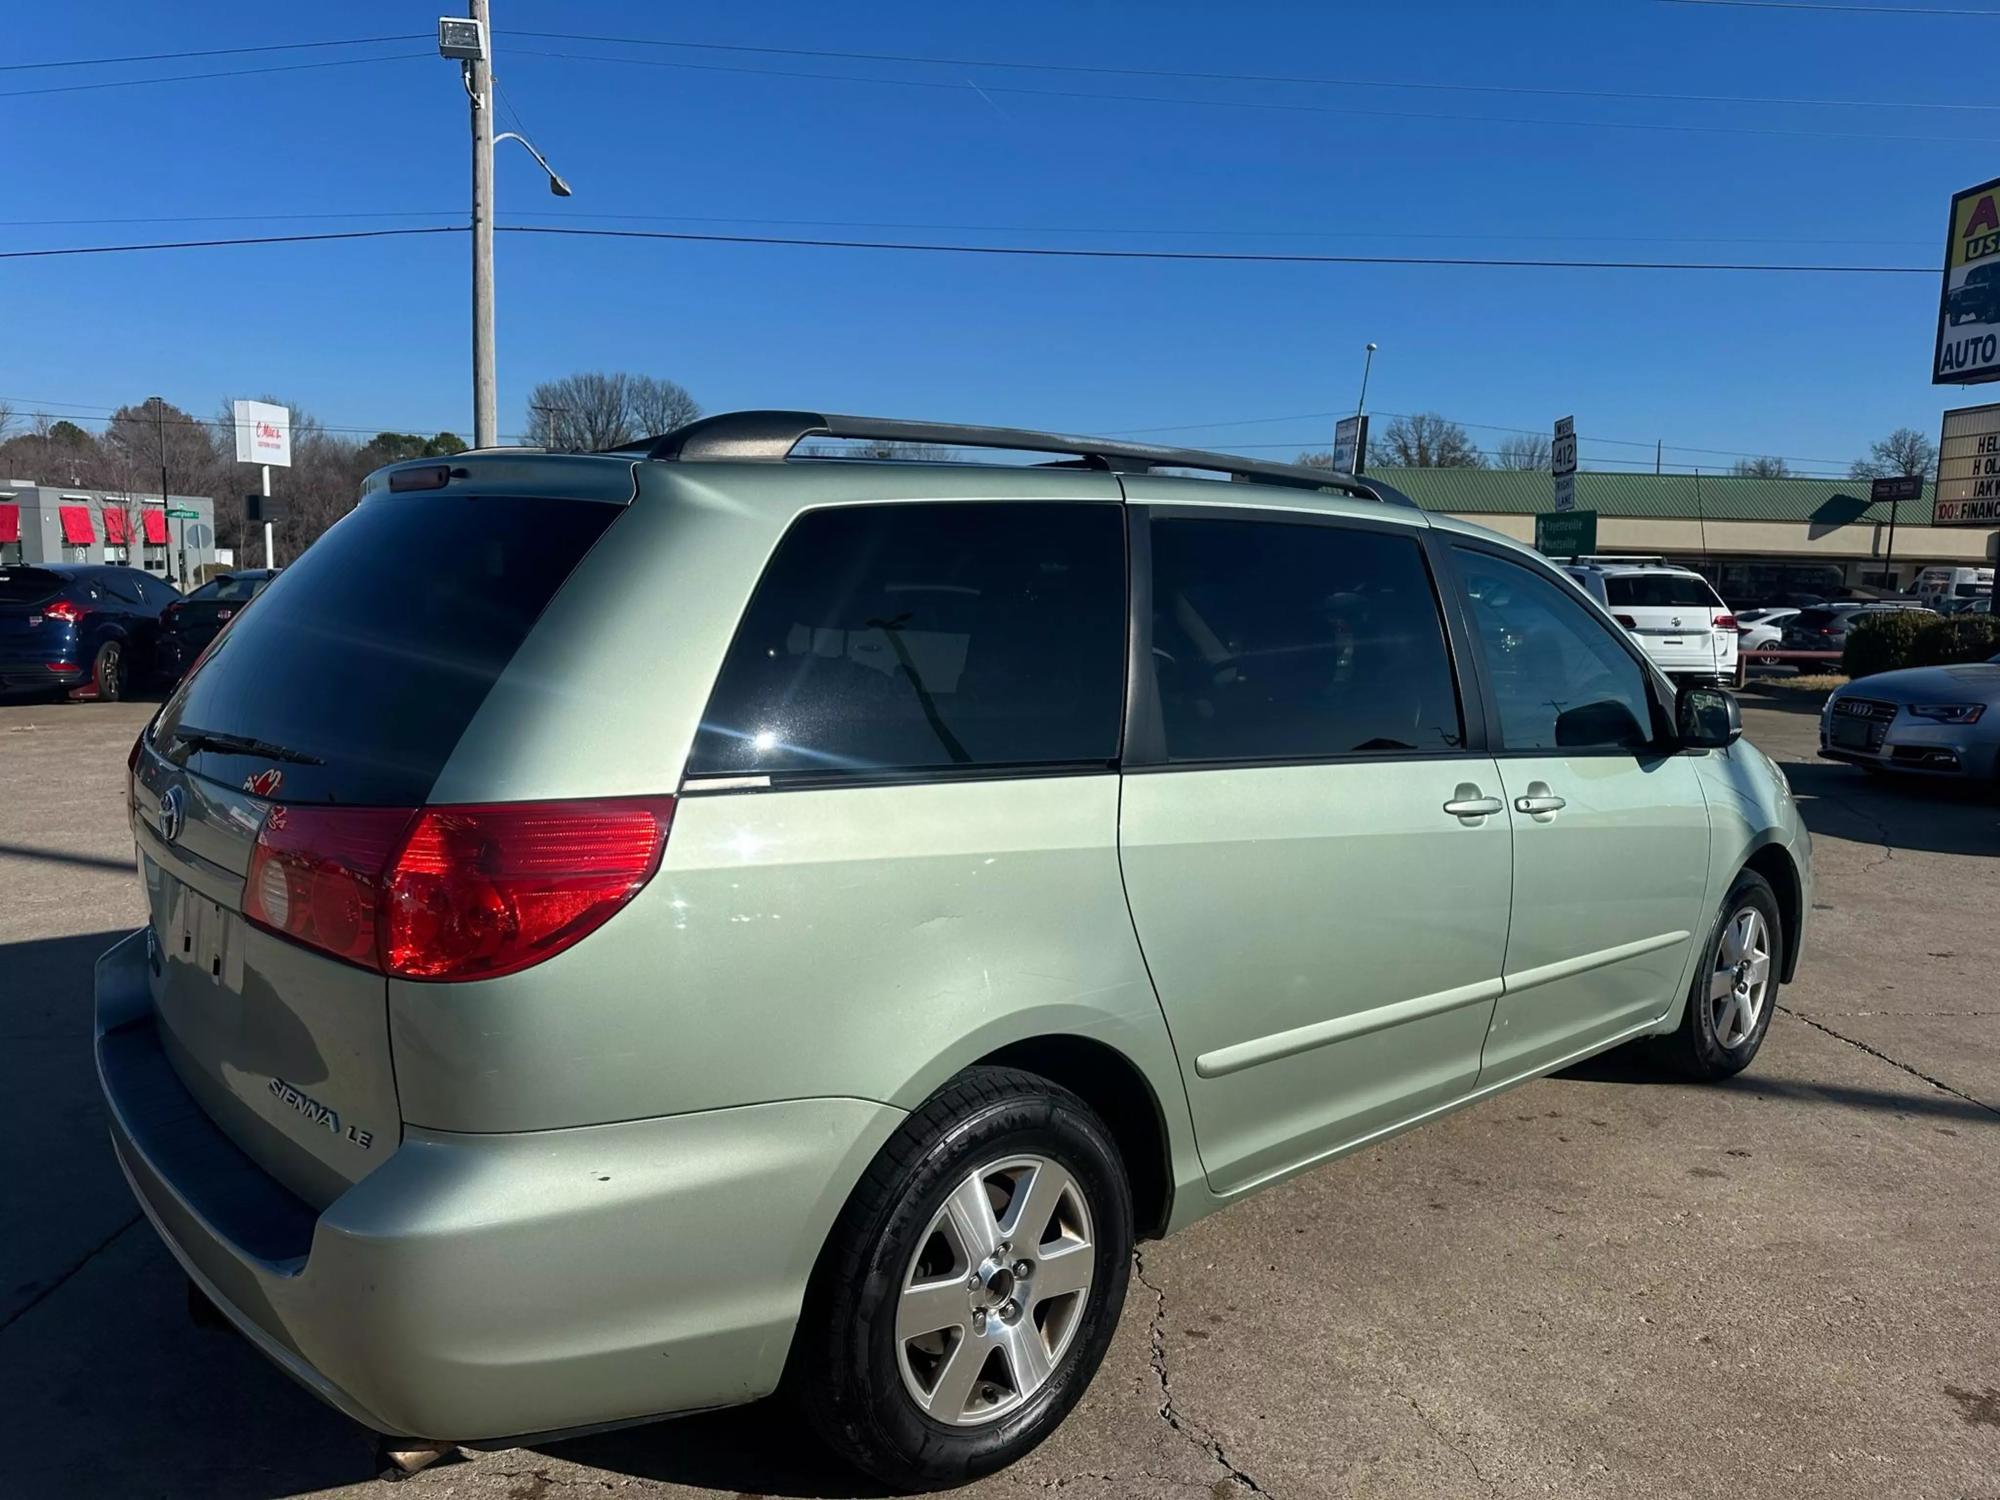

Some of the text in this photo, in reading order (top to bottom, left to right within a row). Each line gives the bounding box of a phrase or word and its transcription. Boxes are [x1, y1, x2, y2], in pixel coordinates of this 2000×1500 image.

[1968, 236, 2000, 259] US
[1940, 333, 1997, 372] AUTO
[1555, 444, 1574, 466] 412
[1978, 436, 2000, 453] HEL
[267, 1078, 373, 1149] SIENNA LE
